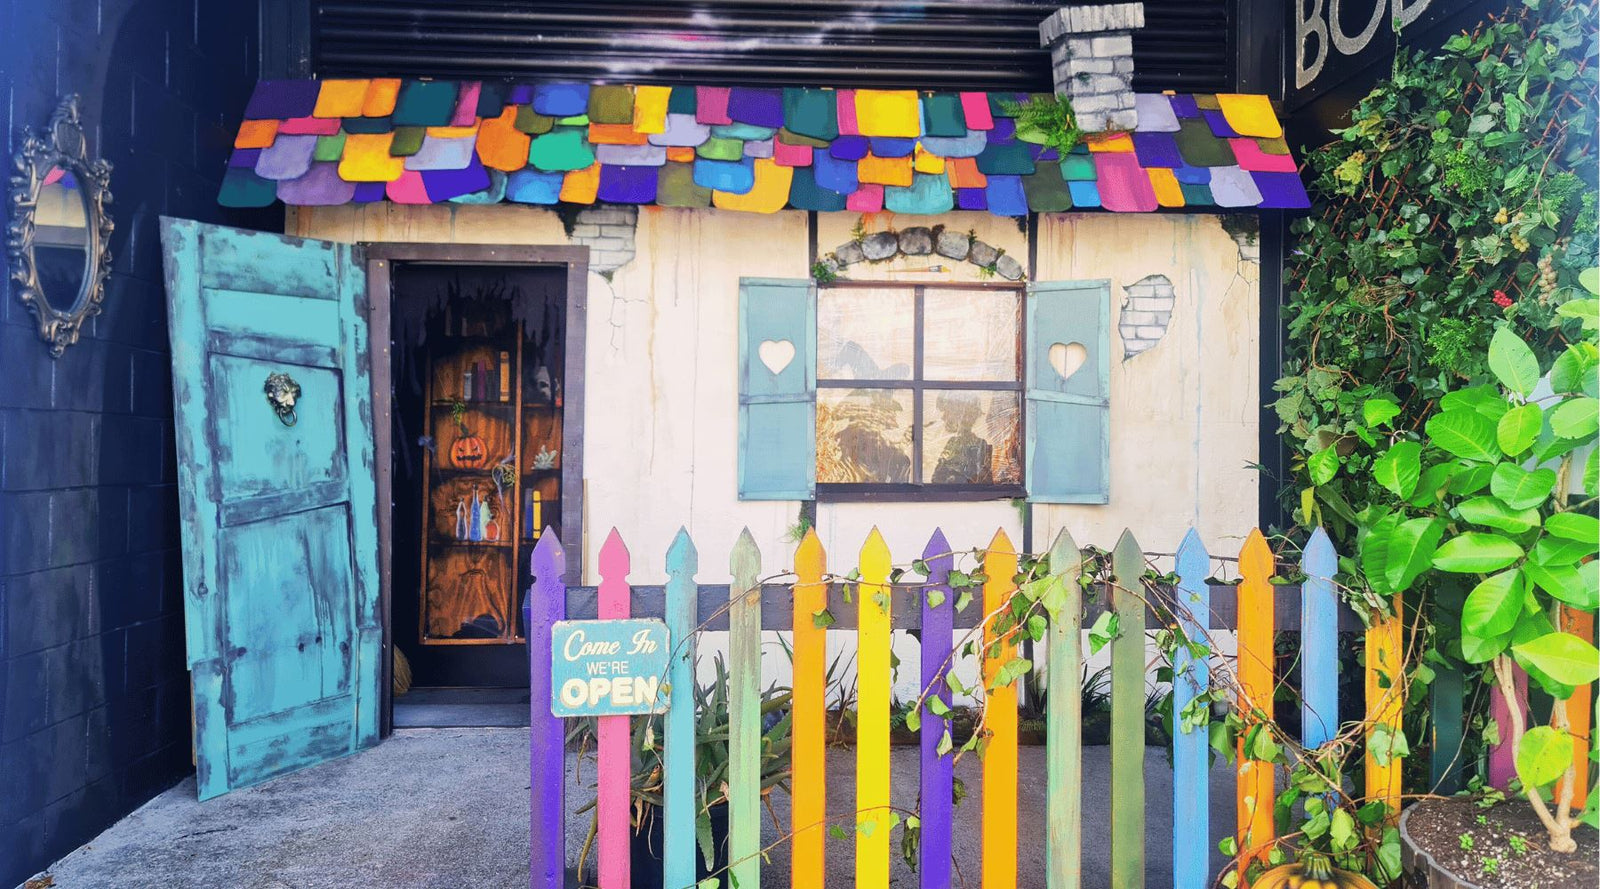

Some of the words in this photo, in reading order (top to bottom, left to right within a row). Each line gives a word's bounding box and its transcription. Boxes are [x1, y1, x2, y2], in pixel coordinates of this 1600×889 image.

[1296, 0, 1432, 89] BO
[564, 629, 620, 661] Come
[627, 629, 658, 655] In
[586, 661, 629, 675] WE'RE
[561, 675, 659, 708] OPEN
